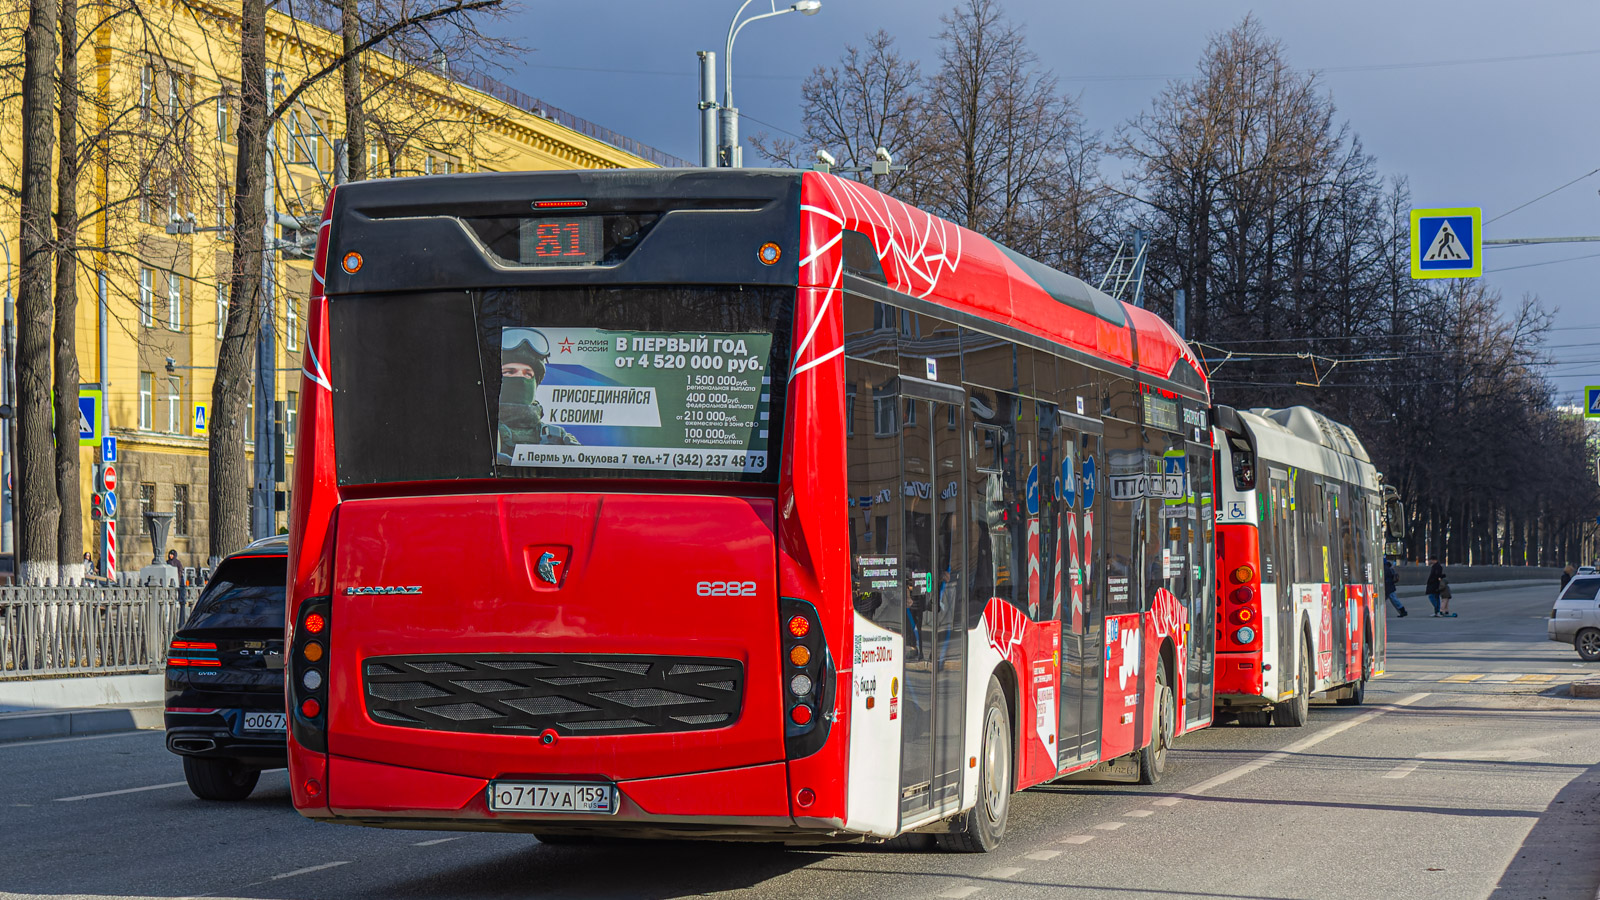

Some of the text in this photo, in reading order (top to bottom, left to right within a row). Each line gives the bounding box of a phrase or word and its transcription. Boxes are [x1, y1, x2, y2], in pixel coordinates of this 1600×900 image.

[536, 223, 586, 257] 81
[616, 335, 748, 356] В ПЕРВЫЙ ГОД
[615, 354, 764, 373] от 4 520 000 руб.
[687, 375, 691, 385] 1
[695, 375, 714, 385] 500
[552, 388, 651, 405] ПРИСОЕДИНЯЙСЯ
[686, 393, 706, 403] 400
[549, 409, 604, 423] К СВОИМ!
[684, 411, 703, 421] 210
[685, 428, 702, 438] 100
[518, 453, 525, 461] г.
[528, 451, 560, 463] Пермь
[562, 454, 575, 464] ул.
[578, 453, 619, 465] Окулова
[622, 454, 628, 464] 7
[672, 453, 703, 468] (342)
[706, 455, 728, 464] 237
[731, 455, 746, 464] 48
[749, 455, 765, 467] 73
[347, 586, 423, 595] KAMAZ
[696, 581, 757, 596] 6282
[862, 646, 893, 667] perm-300.ru
[577, 788, 605, 802] 159
